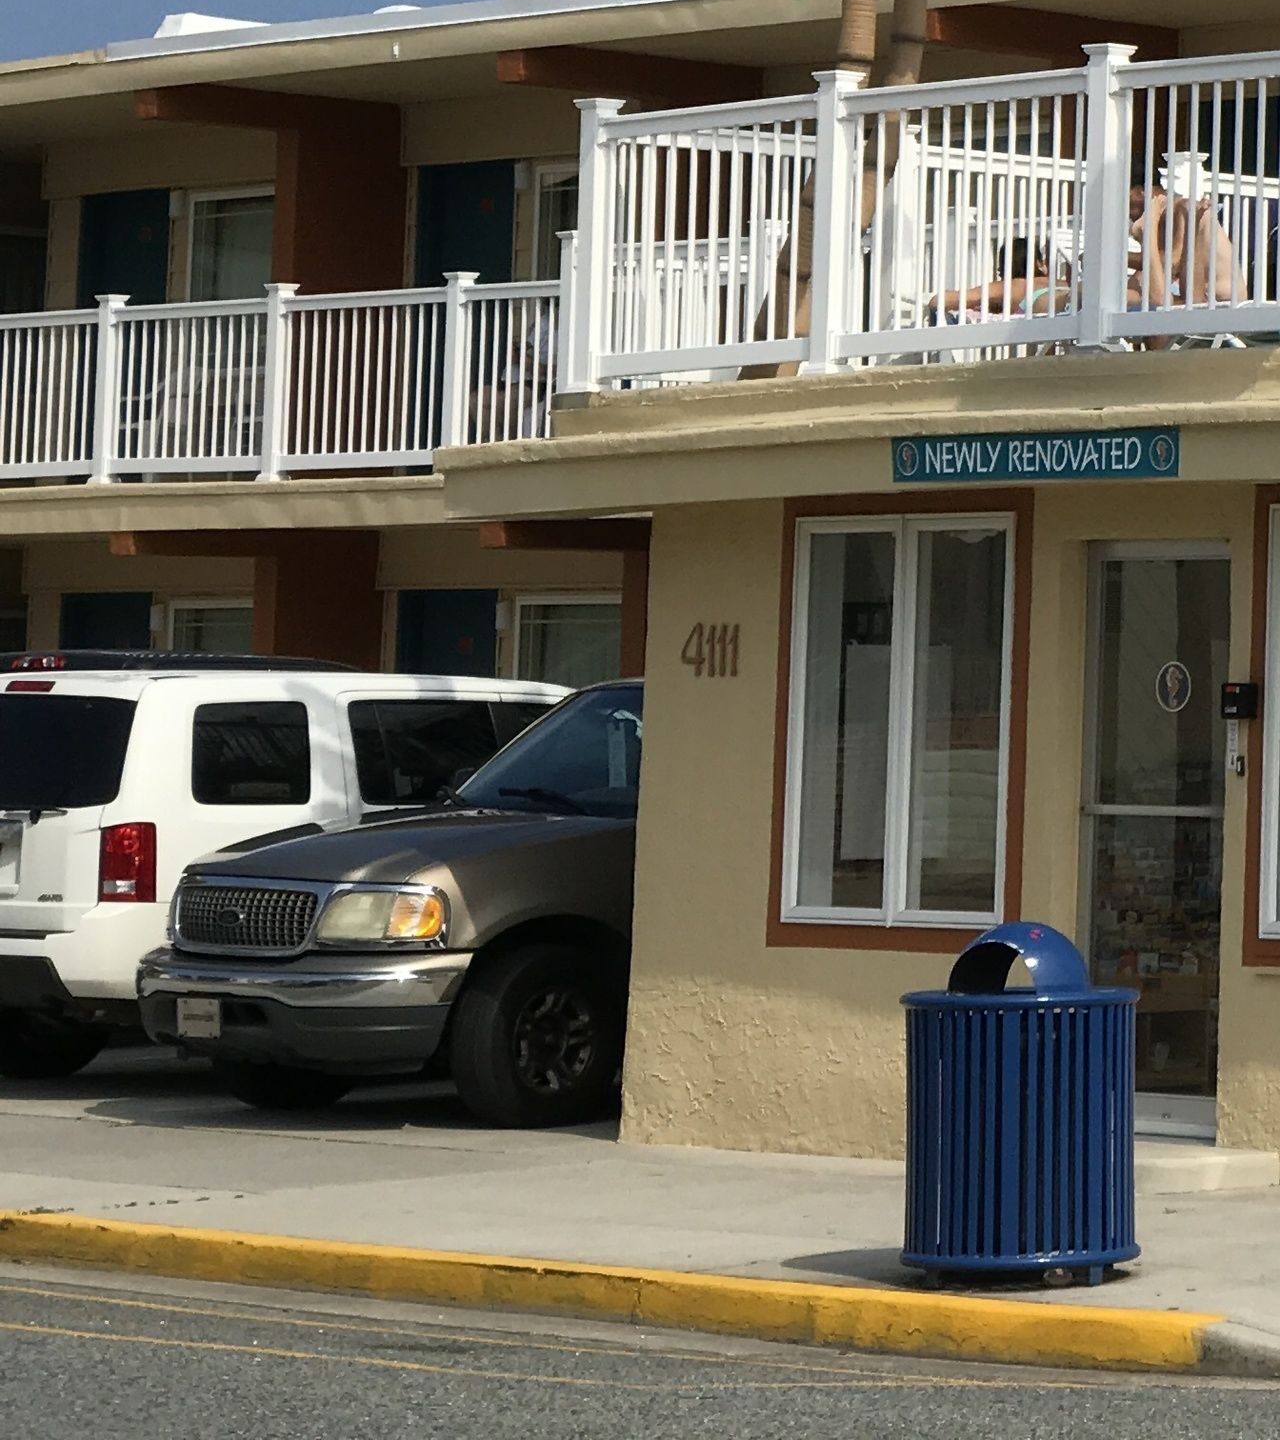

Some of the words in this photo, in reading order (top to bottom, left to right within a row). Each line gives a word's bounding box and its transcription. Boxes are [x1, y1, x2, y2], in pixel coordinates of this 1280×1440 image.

[924, 440, 1003, 475] NEWLY
[1007, 435, 1142, 474] RENOVATED
[680, 621, 741, 678] 4111
